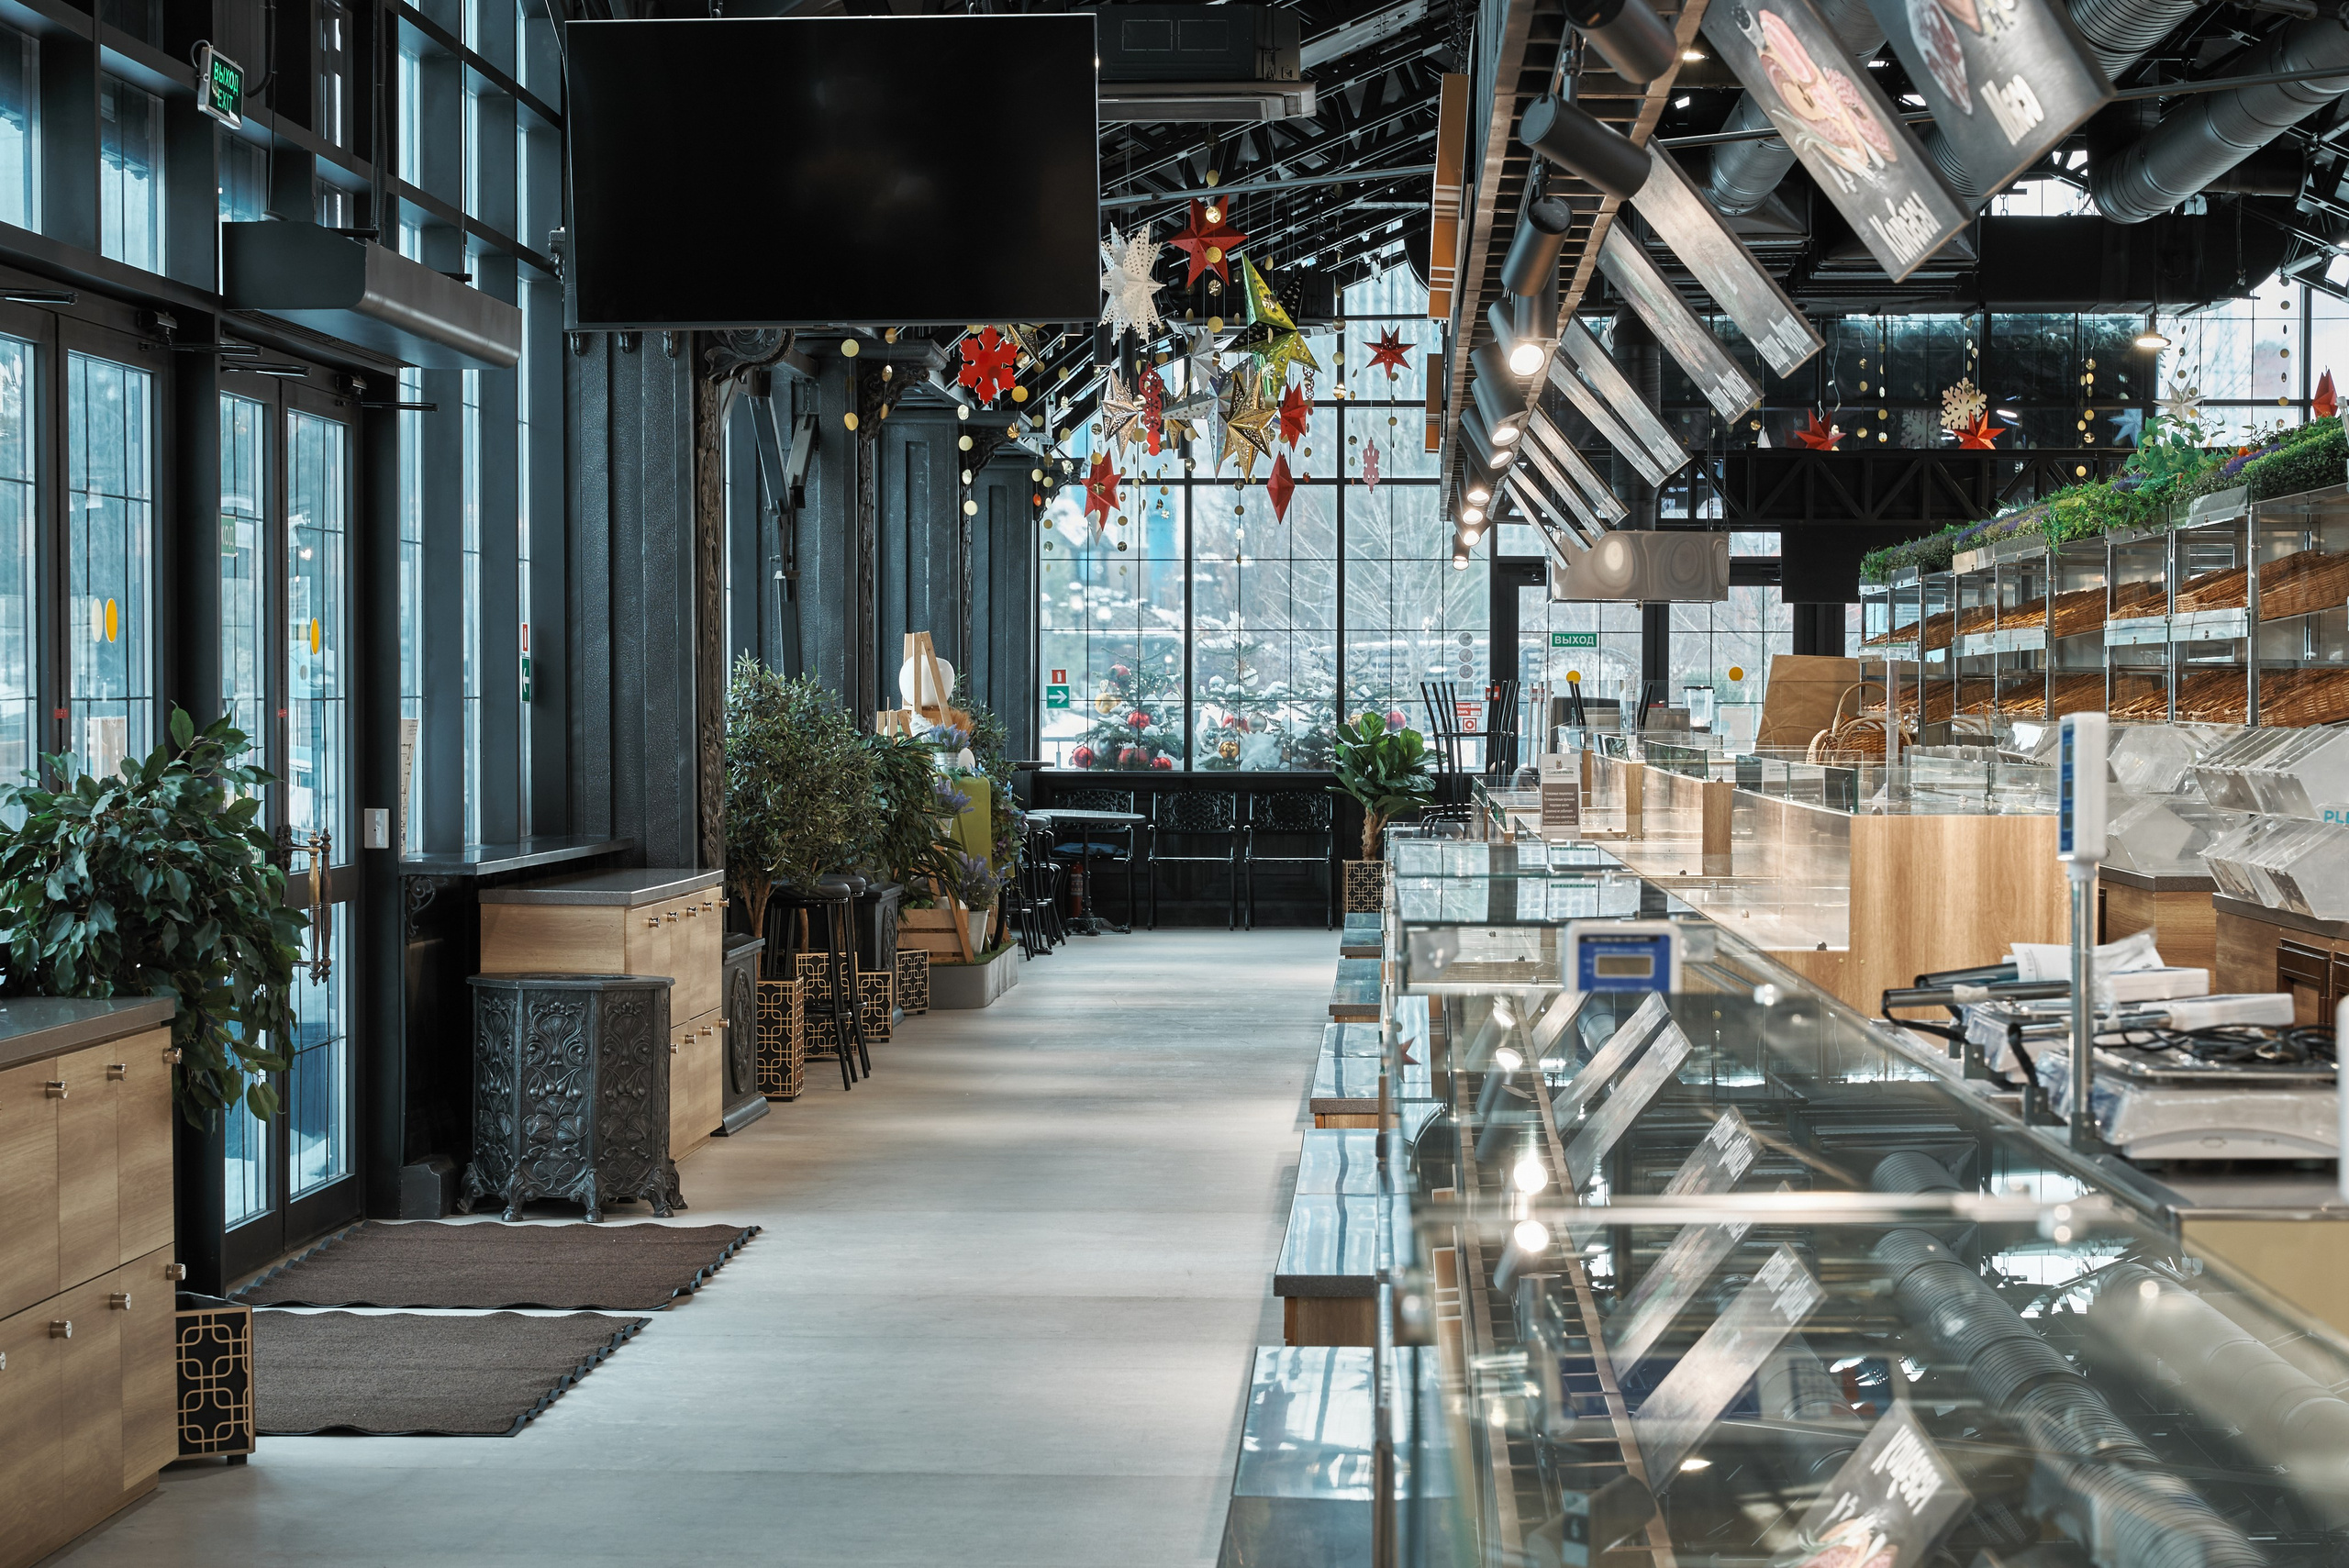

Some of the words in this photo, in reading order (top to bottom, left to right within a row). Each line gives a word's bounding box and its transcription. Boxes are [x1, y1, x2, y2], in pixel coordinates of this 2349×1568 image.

[214, 61, 239, 96] ВЫХОД
[217, 88, 234, 111] EXIT
[1980, 73, 2044, 146] Мясо
[1868, 190, 1942, 264] Колбасы
[1554, 636, 1594, 646] ВЫХОД
